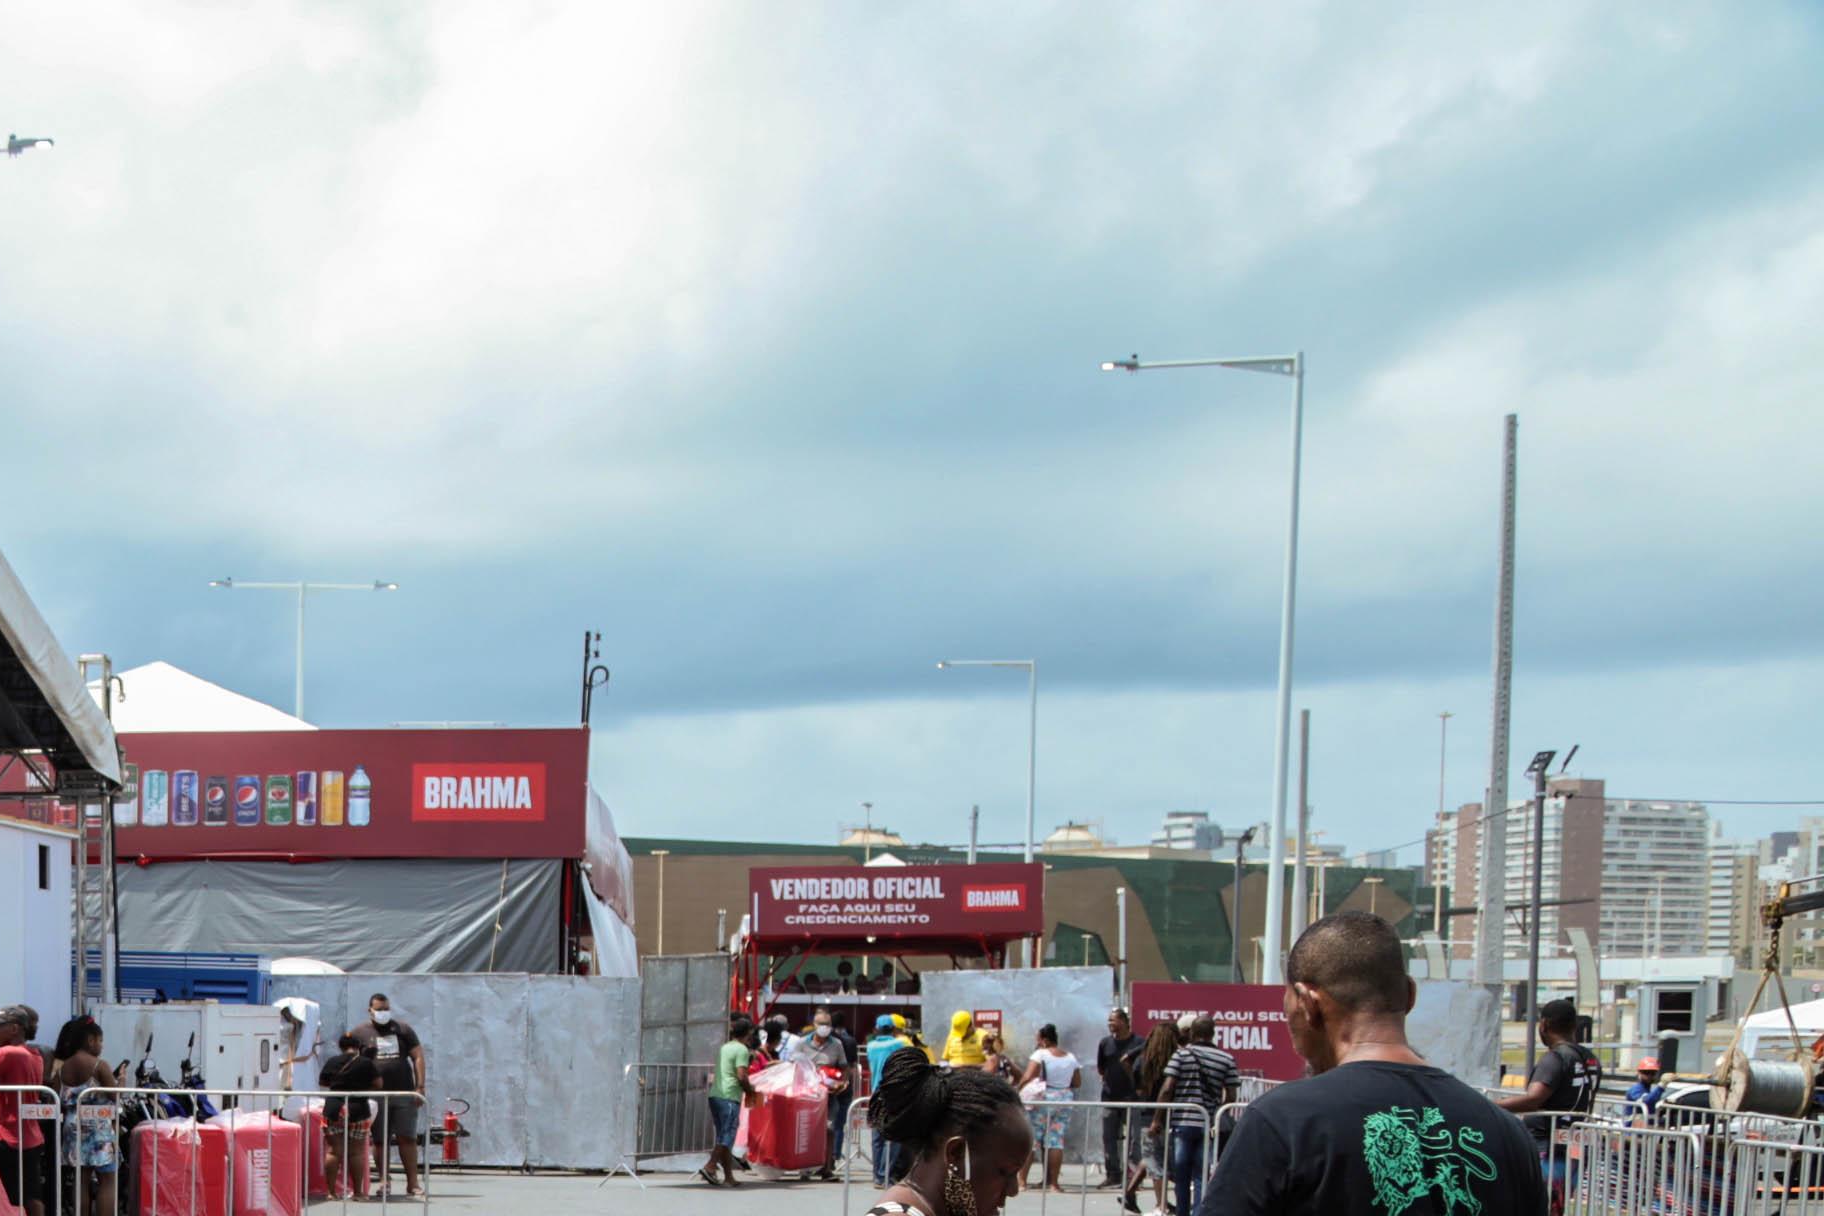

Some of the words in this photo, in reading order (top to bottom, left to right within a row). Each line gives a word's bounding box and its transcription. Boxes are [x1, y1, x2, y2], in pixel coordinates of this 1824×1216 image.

[424, 776, 532, 809] BRAHMA
[770, 878, 869, 900] VENDEDOR
[873, 877, 945, 899] OFICIAL
[966, 889, 1020, 907] BRAHMA
[798, 903, 840, 914] FAÇA
[843, 903, 881, 914] AQUI
[884, 903, 916, 913] SEU
[784, 914, 930, 925] CREDENCIAMENTO
[1212, 1010, 1253, 1021] AQUI
[1257, 1010, 1289, 1022] SEU
[1212, 1025, 1273, 1050] FICIAL
